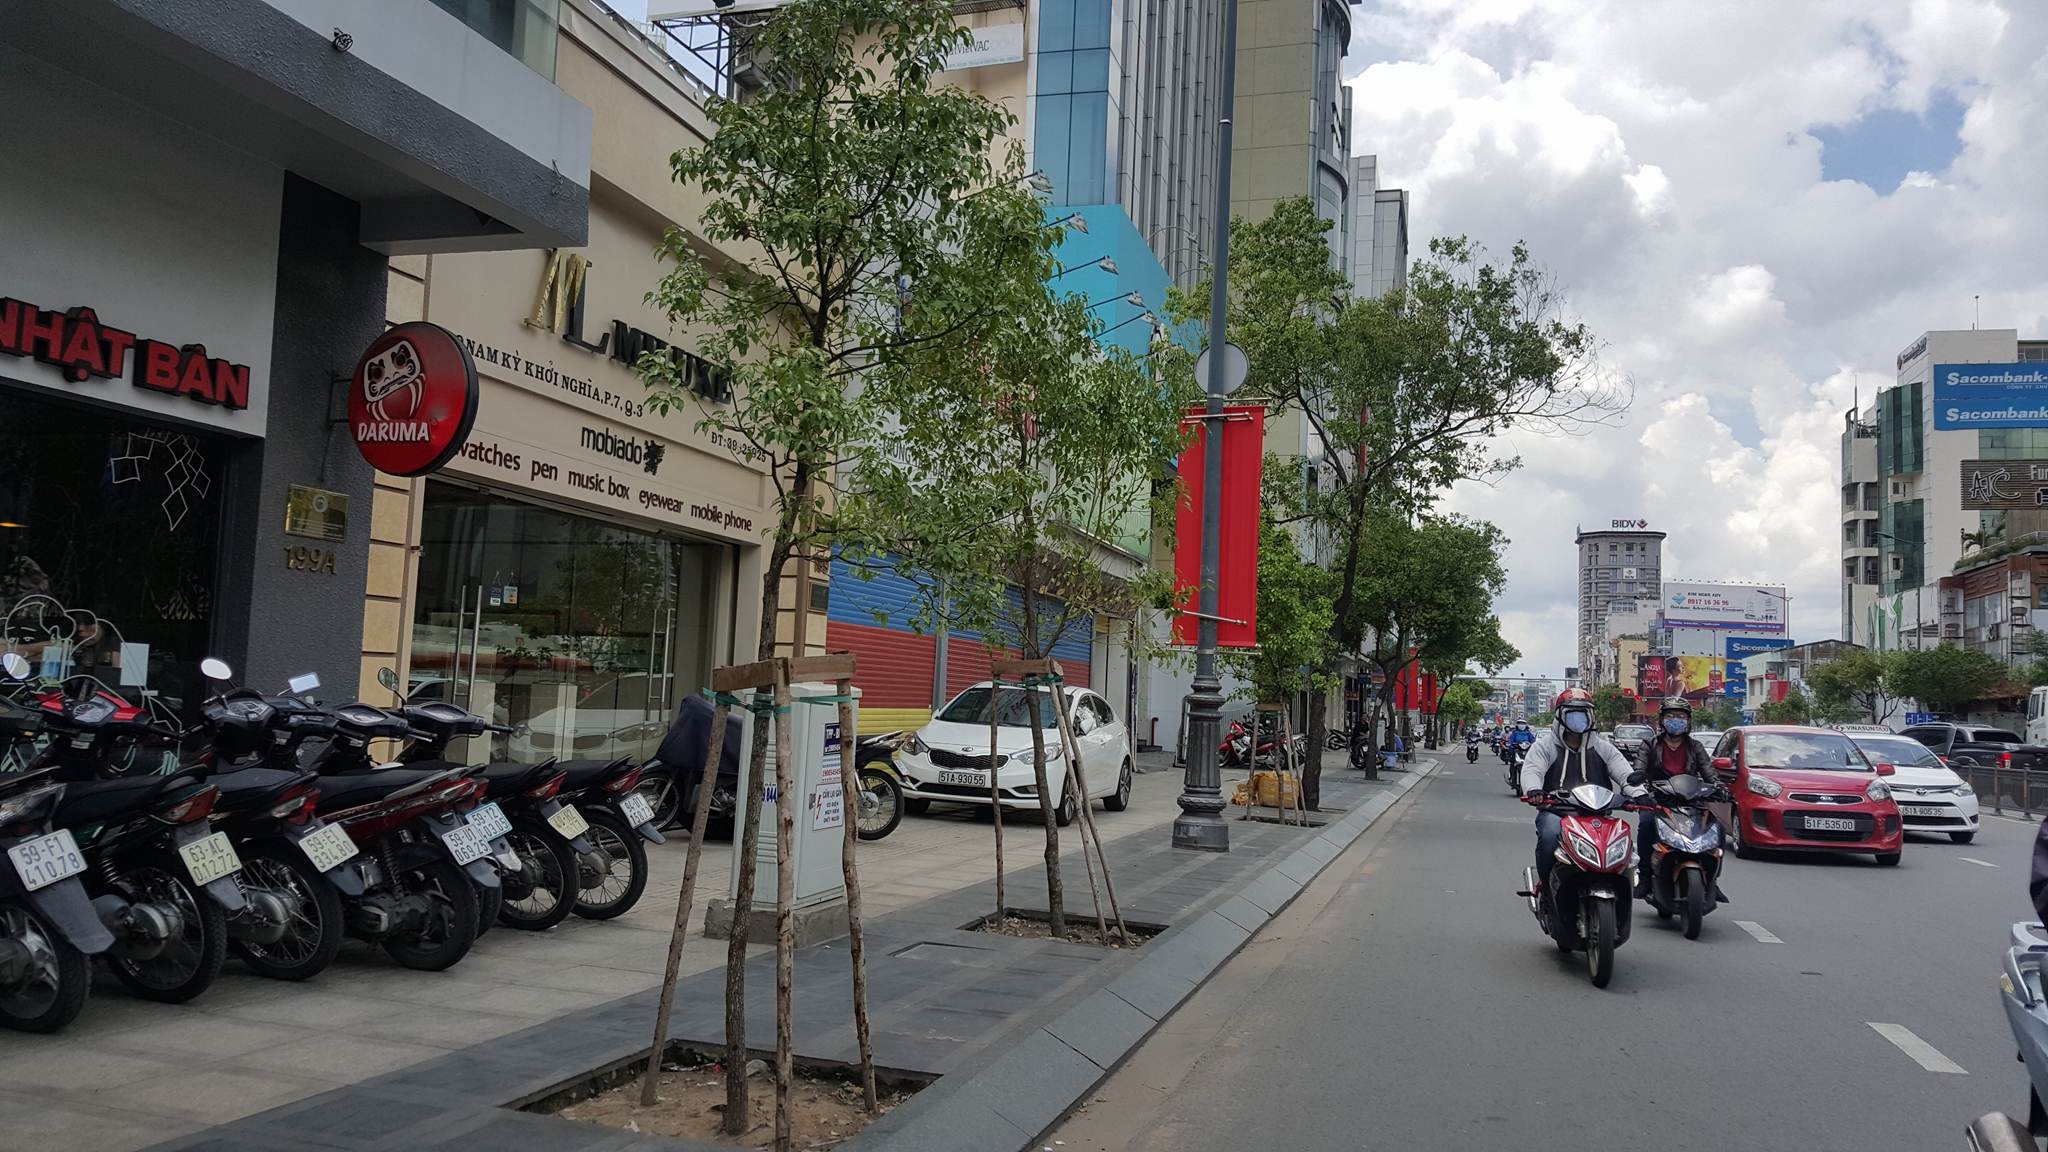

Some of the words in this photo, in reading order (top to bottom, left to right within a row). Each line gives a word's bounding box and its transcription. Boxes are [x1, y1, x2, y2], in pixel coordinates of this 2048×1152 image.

[501, 350, 521, 372] KỲ
[357, 421, 430, 442] DARUMA
[581, 425, 643, 465] mobiado
[530, 460, 558, 481] pen
[568, 470, 605, 493] music
[608, 475, 630, 500] box
[639, 489, 684, 513] eyewear
[691, 503, 723, 524] mobile
[724, 510, 753, 532] phone
[1612, 519, 1637, 528] BIDV
[284, 545, 337, 575] 199A
[941, 772, 984, 785] 51A-930.55
[1806, 819, 1853, 830] 51F-535.00
[20, 836, 64, 865] 59-F1
[189, 838, 224, 863] 63-AC
[306, 829, 340, 853] 59-E1
[455, 839, 489, 862] 069.25
[25, 852, 80, 886] 410.78
